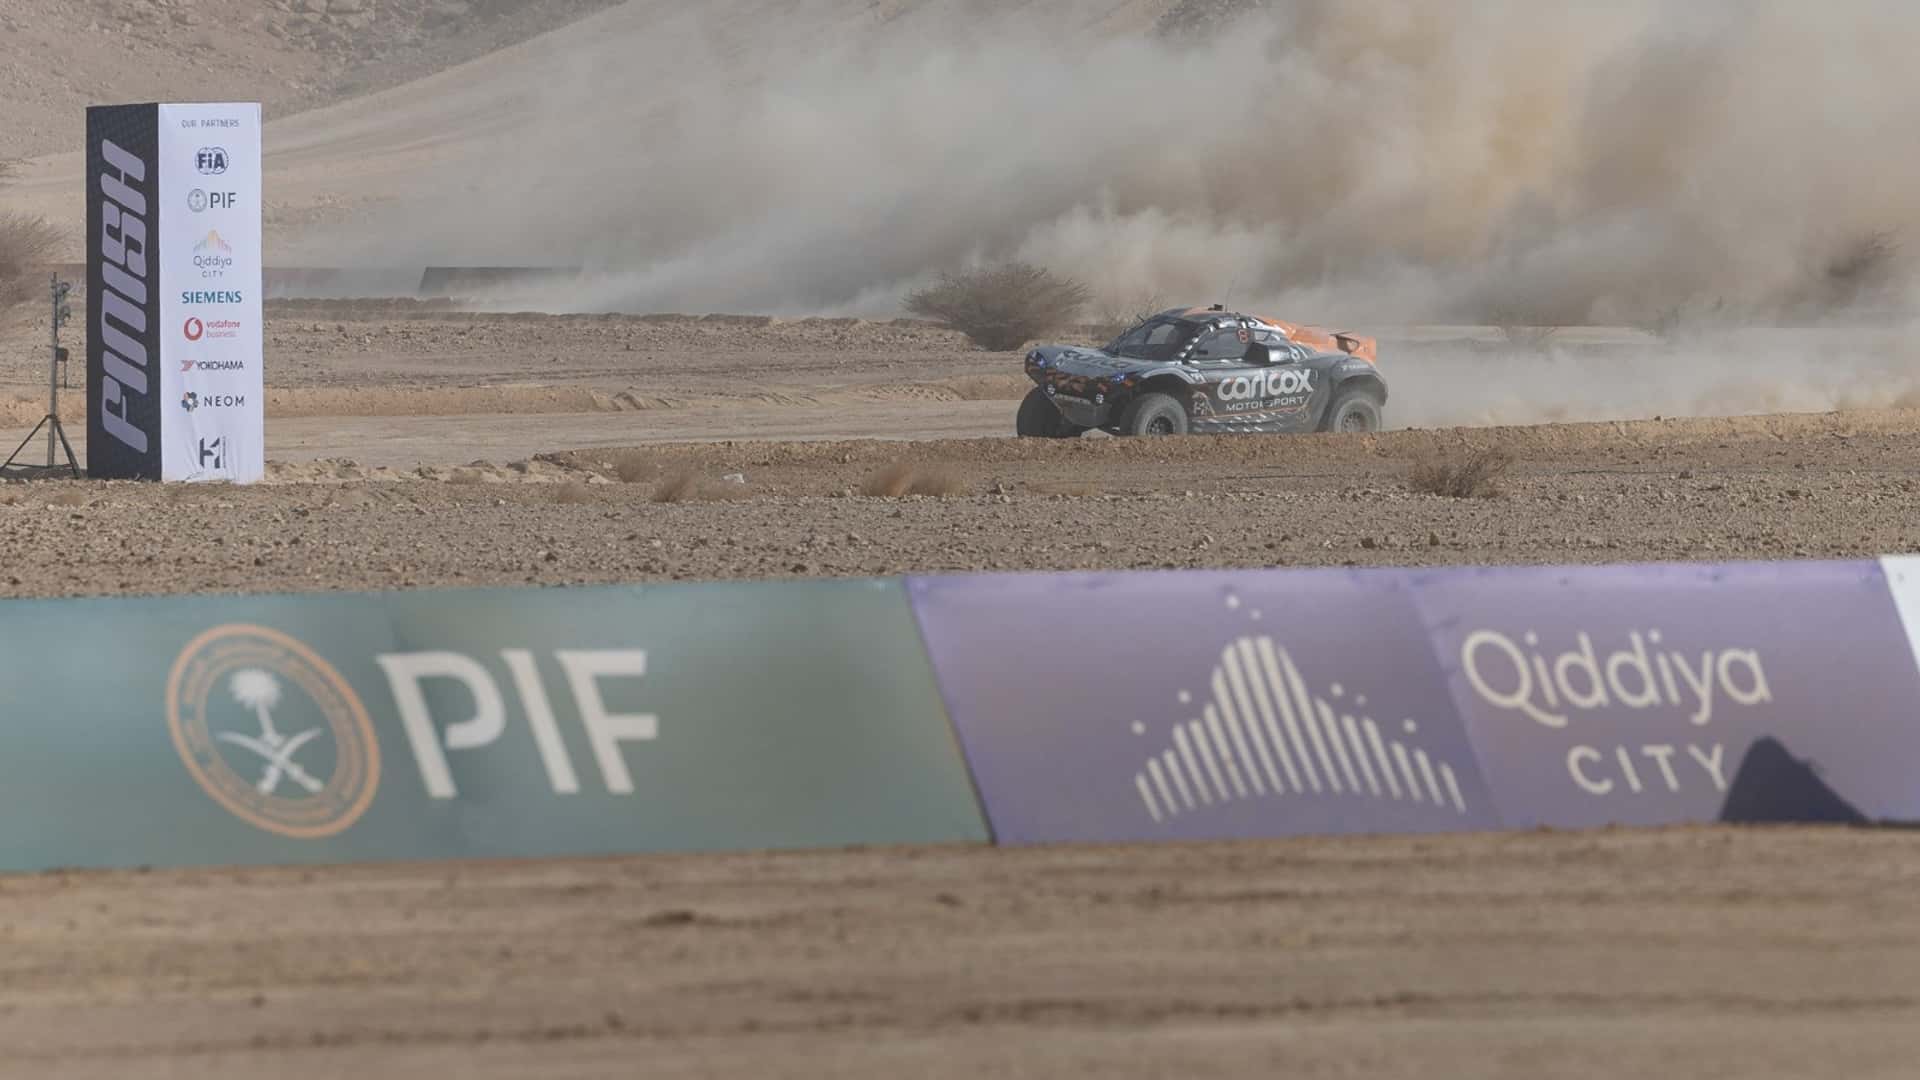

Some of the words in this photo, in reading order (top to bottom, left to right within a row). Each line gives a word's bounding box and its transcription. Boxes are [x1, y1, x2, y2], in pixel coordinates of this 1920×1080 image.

[201, 119, 239, 128] PARTNERS
[210, 192, 237, 208] PIF
[193, 255, 232, 268] Qiddiya
[101, 138, 148, 454] FINISH
[182, 291, 242, 304] SIEMENS
[206, 320, 241, 328] vodafone
[197, 361, 244, 370] YOKOHAMA
[204, 395, 245, 407] NEOM
[1461, 629, 1773, 727] Qiddiya
[376, 648, 660, 798] PIF
[1567, 743, 1728, 795] CITY
